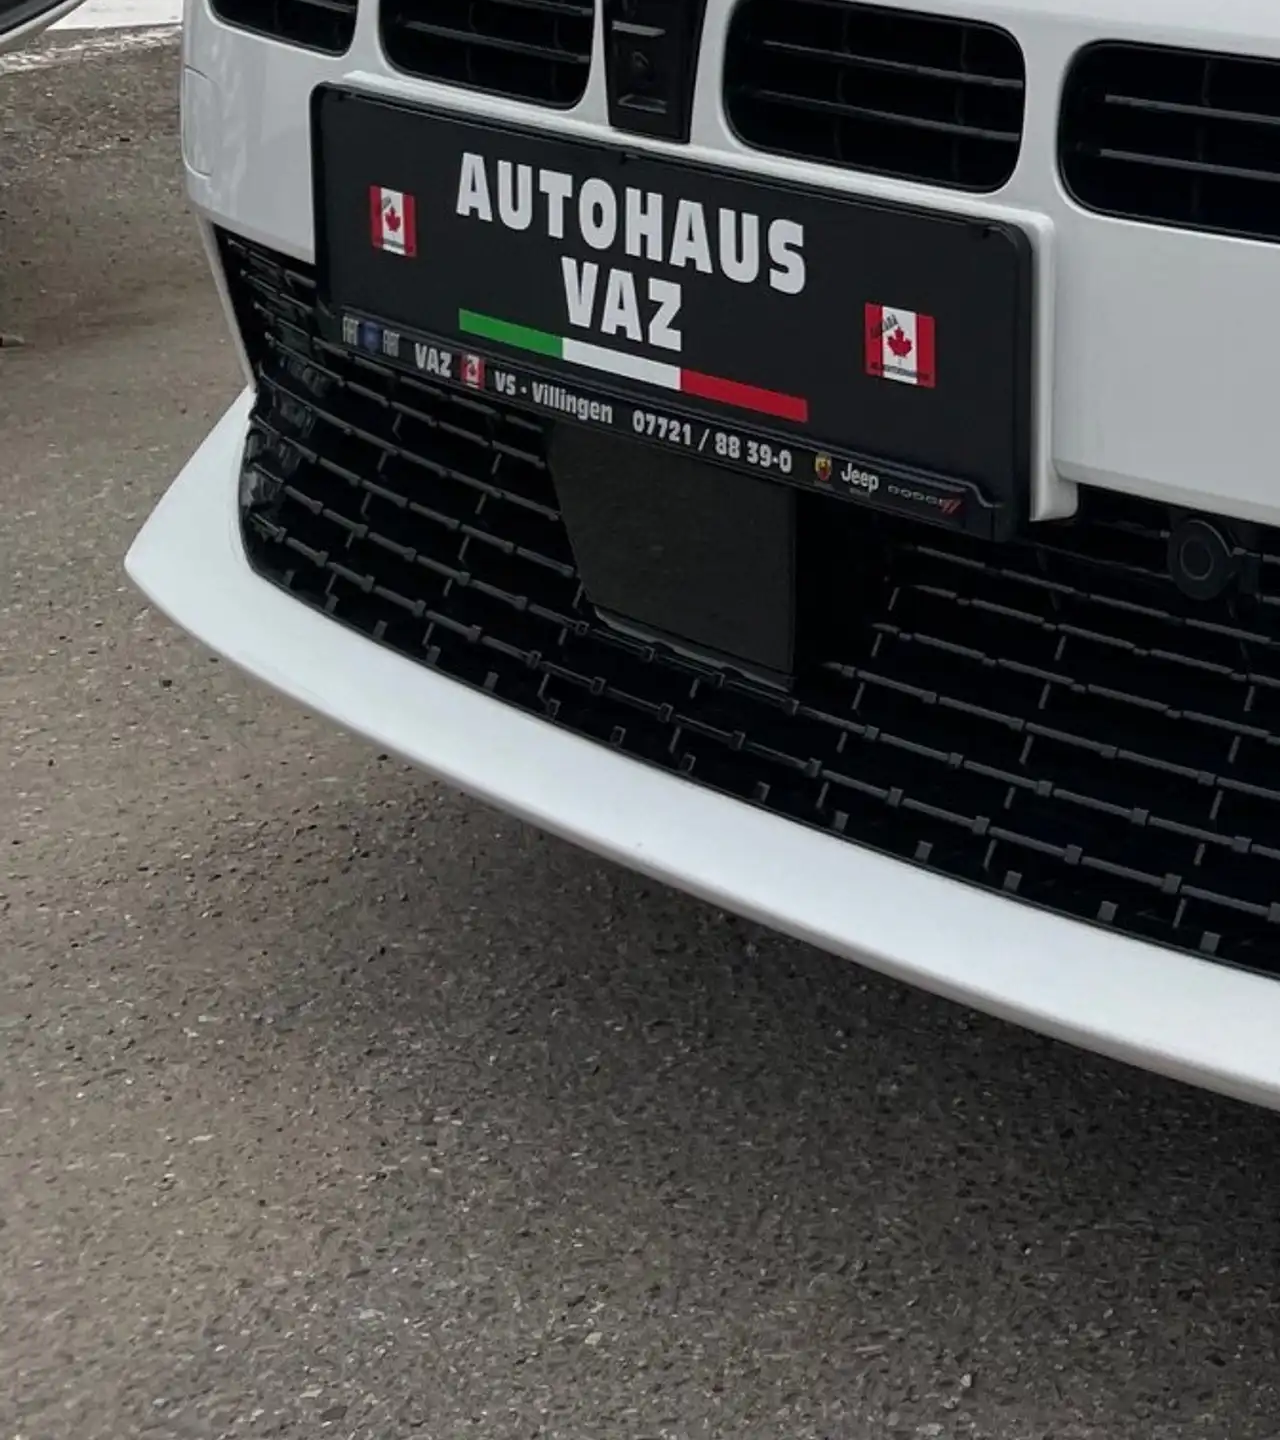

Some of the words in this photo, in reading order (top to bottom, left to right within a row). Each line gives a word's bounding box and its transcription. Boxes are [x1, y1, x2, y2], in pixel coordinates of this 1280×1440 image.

[455, 152, 806, 295] AUTOHAUS
[561, 256, 682, 352] VAZ
[414, 342, 452, 378] VAZ
[494, 371, 517, 396] VS
[531, 381, 613, 424] Villingen
[632, 410, 692, 445] 07721
[715, 432, 741, 459] 88
[840, 462, 879, 492] Jeep
